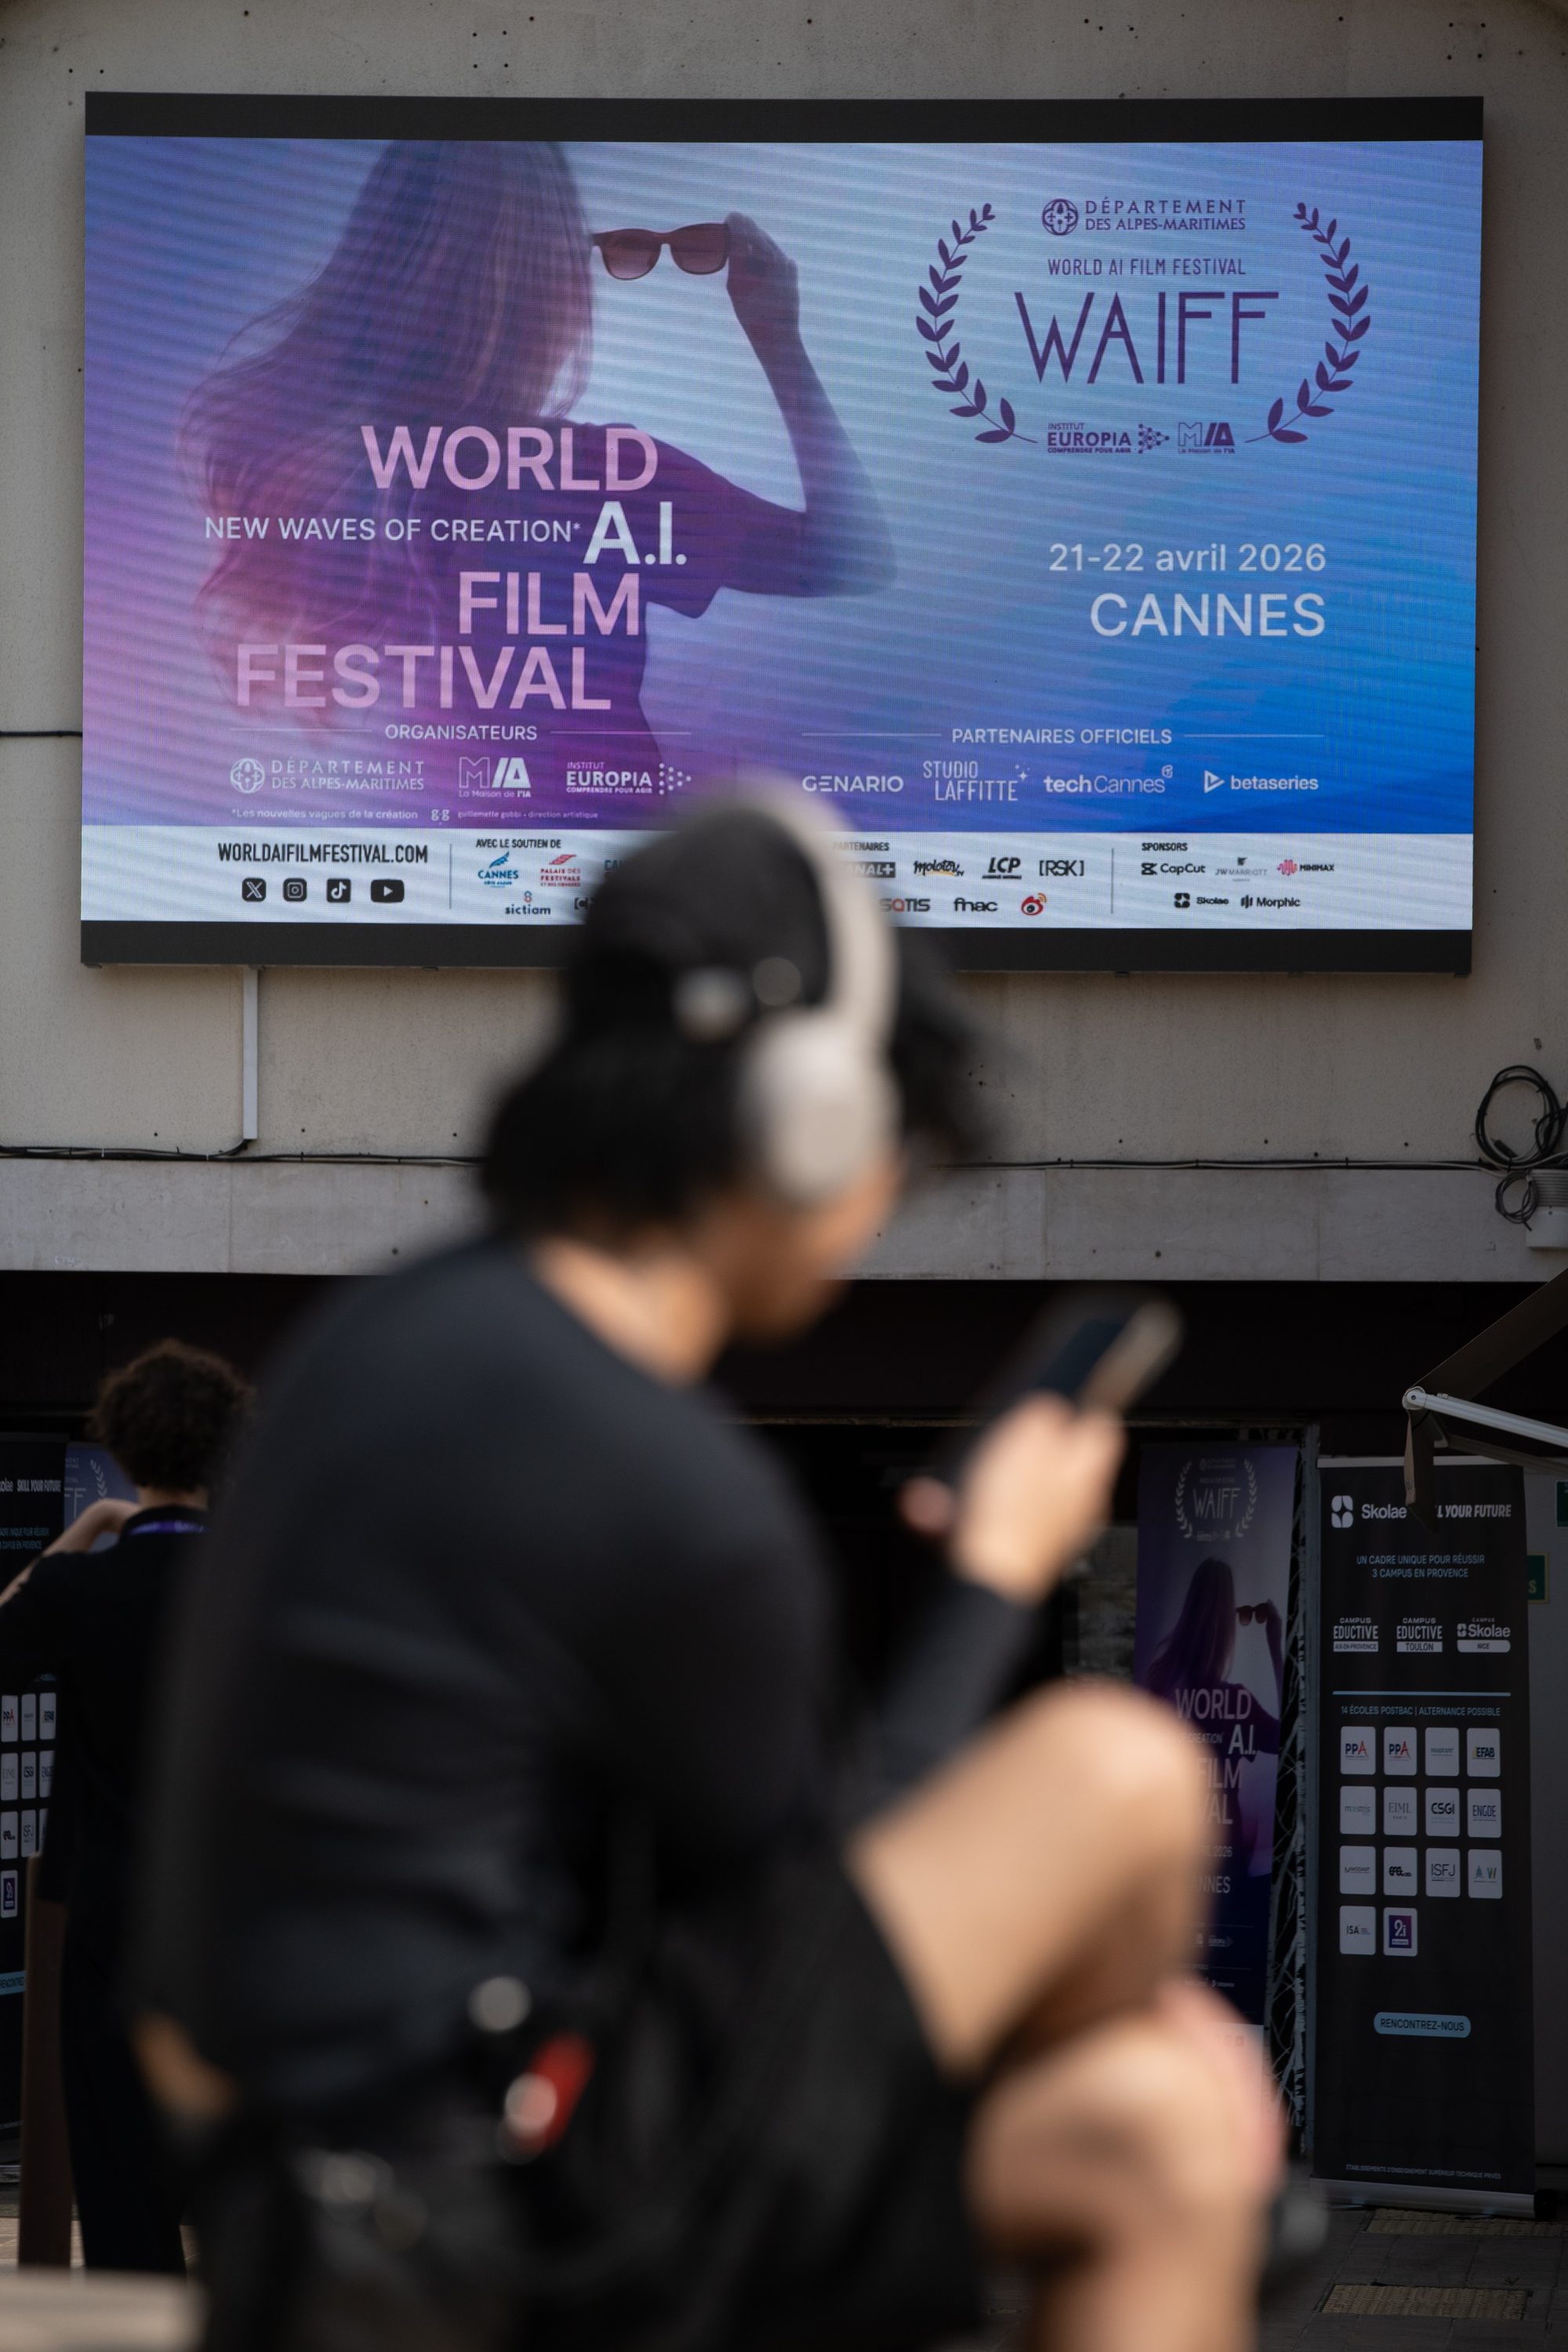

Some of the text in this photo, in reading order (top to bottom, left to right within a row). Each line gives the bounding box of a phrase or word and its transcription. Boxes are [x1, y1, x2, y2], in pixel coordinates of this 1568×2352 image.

[1085, 197, 1246, 214] DÉPARTEMENT
[1085, 217, 1246, 230] DES ALPES-MARITIMES
[1047, 258, 1247, 275] WORLD AI FILM FESTIVAL
[1014, 292, 1279, 384] WAIFF
[1047, 432, 1132, 447] EUROPIA
[361, 425, 659, 492] WORLD
[205, 517, 270, 540] NEW
[278, 518, 376, 541] WAVES
[385, 519, 422, 542] OF
[583, 501, 688, 565] A.I.
[1049, 543, 1327, 572] 21-22 avril 2026
[459, 572, 640, 636] FILM
[1090, 593, 1326, 637] CANNES
[237, 643, 612, 710] FESTIVAL
[384, 724, 538, 741] ORGANISATEURS
[952, 728, 1173, 745] PARTENAIRES OFFICIELS
[271, 757, 424, 775] DÉPARTEMENT
[923, 760, 979, 779] STUDIO
[271, 777, 424, 790] DES ALPES-MARITIMES
[565, 771, 653, 786] EUROPIA
[1230, 775, 1319, 790] betaseries
[935, 780, 1018, 801] LAFFITTE
[376, 809, 419, 819] création
[476, 839, 561, 849] AVEC LE SOUTIEN DE
[835, 841, 890, 851] RTENAIRES
[1142, 842, 1189, 851] SPONSORS
[218, 842, 429, 863] WORLDAIFILMFESTIVAL.COM
[988, 857, 1022, 873] LCP
[1160, 863, 1206, 875] CapCut
[477, 869, 519, 880] CANNES
[953, 897, 999, 912] fnac
[1256, 897, 1301, 909] Morphic
[1192, 1488, 1241, 1519] WAIFF
[1361, 1503, 1408, 1519] Skolae
[1445, 1504, 1472, 1519] YOUR
[1474, 1504, 1512, 1519] FUTURE
[1356, 1552, 1486, 1566] UN CADRE UNIQUE POUR RÉUSSIR
[1372, 1568, 1469, 1578] 3 CAMPUS EN PROVENCE
[1333, 1625, 1379, 1640] EDUCTIVE
[1396, 1625, 1443, 1640] EDUCTIVE
[1468, 1623, 1512, 1638] Skolae
[1405, 1642, 1434, 1651] TOULON
[1175, 1688, 1252, 1720] WORLD
[1348, 1704, 1380, 1715] ÉCOLES
[1381, 1706, 1414, 1715] POSTBAC
[1418, 1706, 1466, 1716] ALTERNANCE
[1467, 1707, 1501, 1717] POSSIBLE
[1345, 1740, 1369, 1757] PPA
[1388, 1740, 1410, 1757] PPA
[1475, 1746, 1495, 1759] EFAB
[1472, 1805, 1497, 1817] ENGDE
[1431, 1864, 1456, 1877] ISFJ
[1346, 1926, 1359, 1935] ISA
[1380, 2018, 1465, 2031] RENCONTREZ-NOUS
